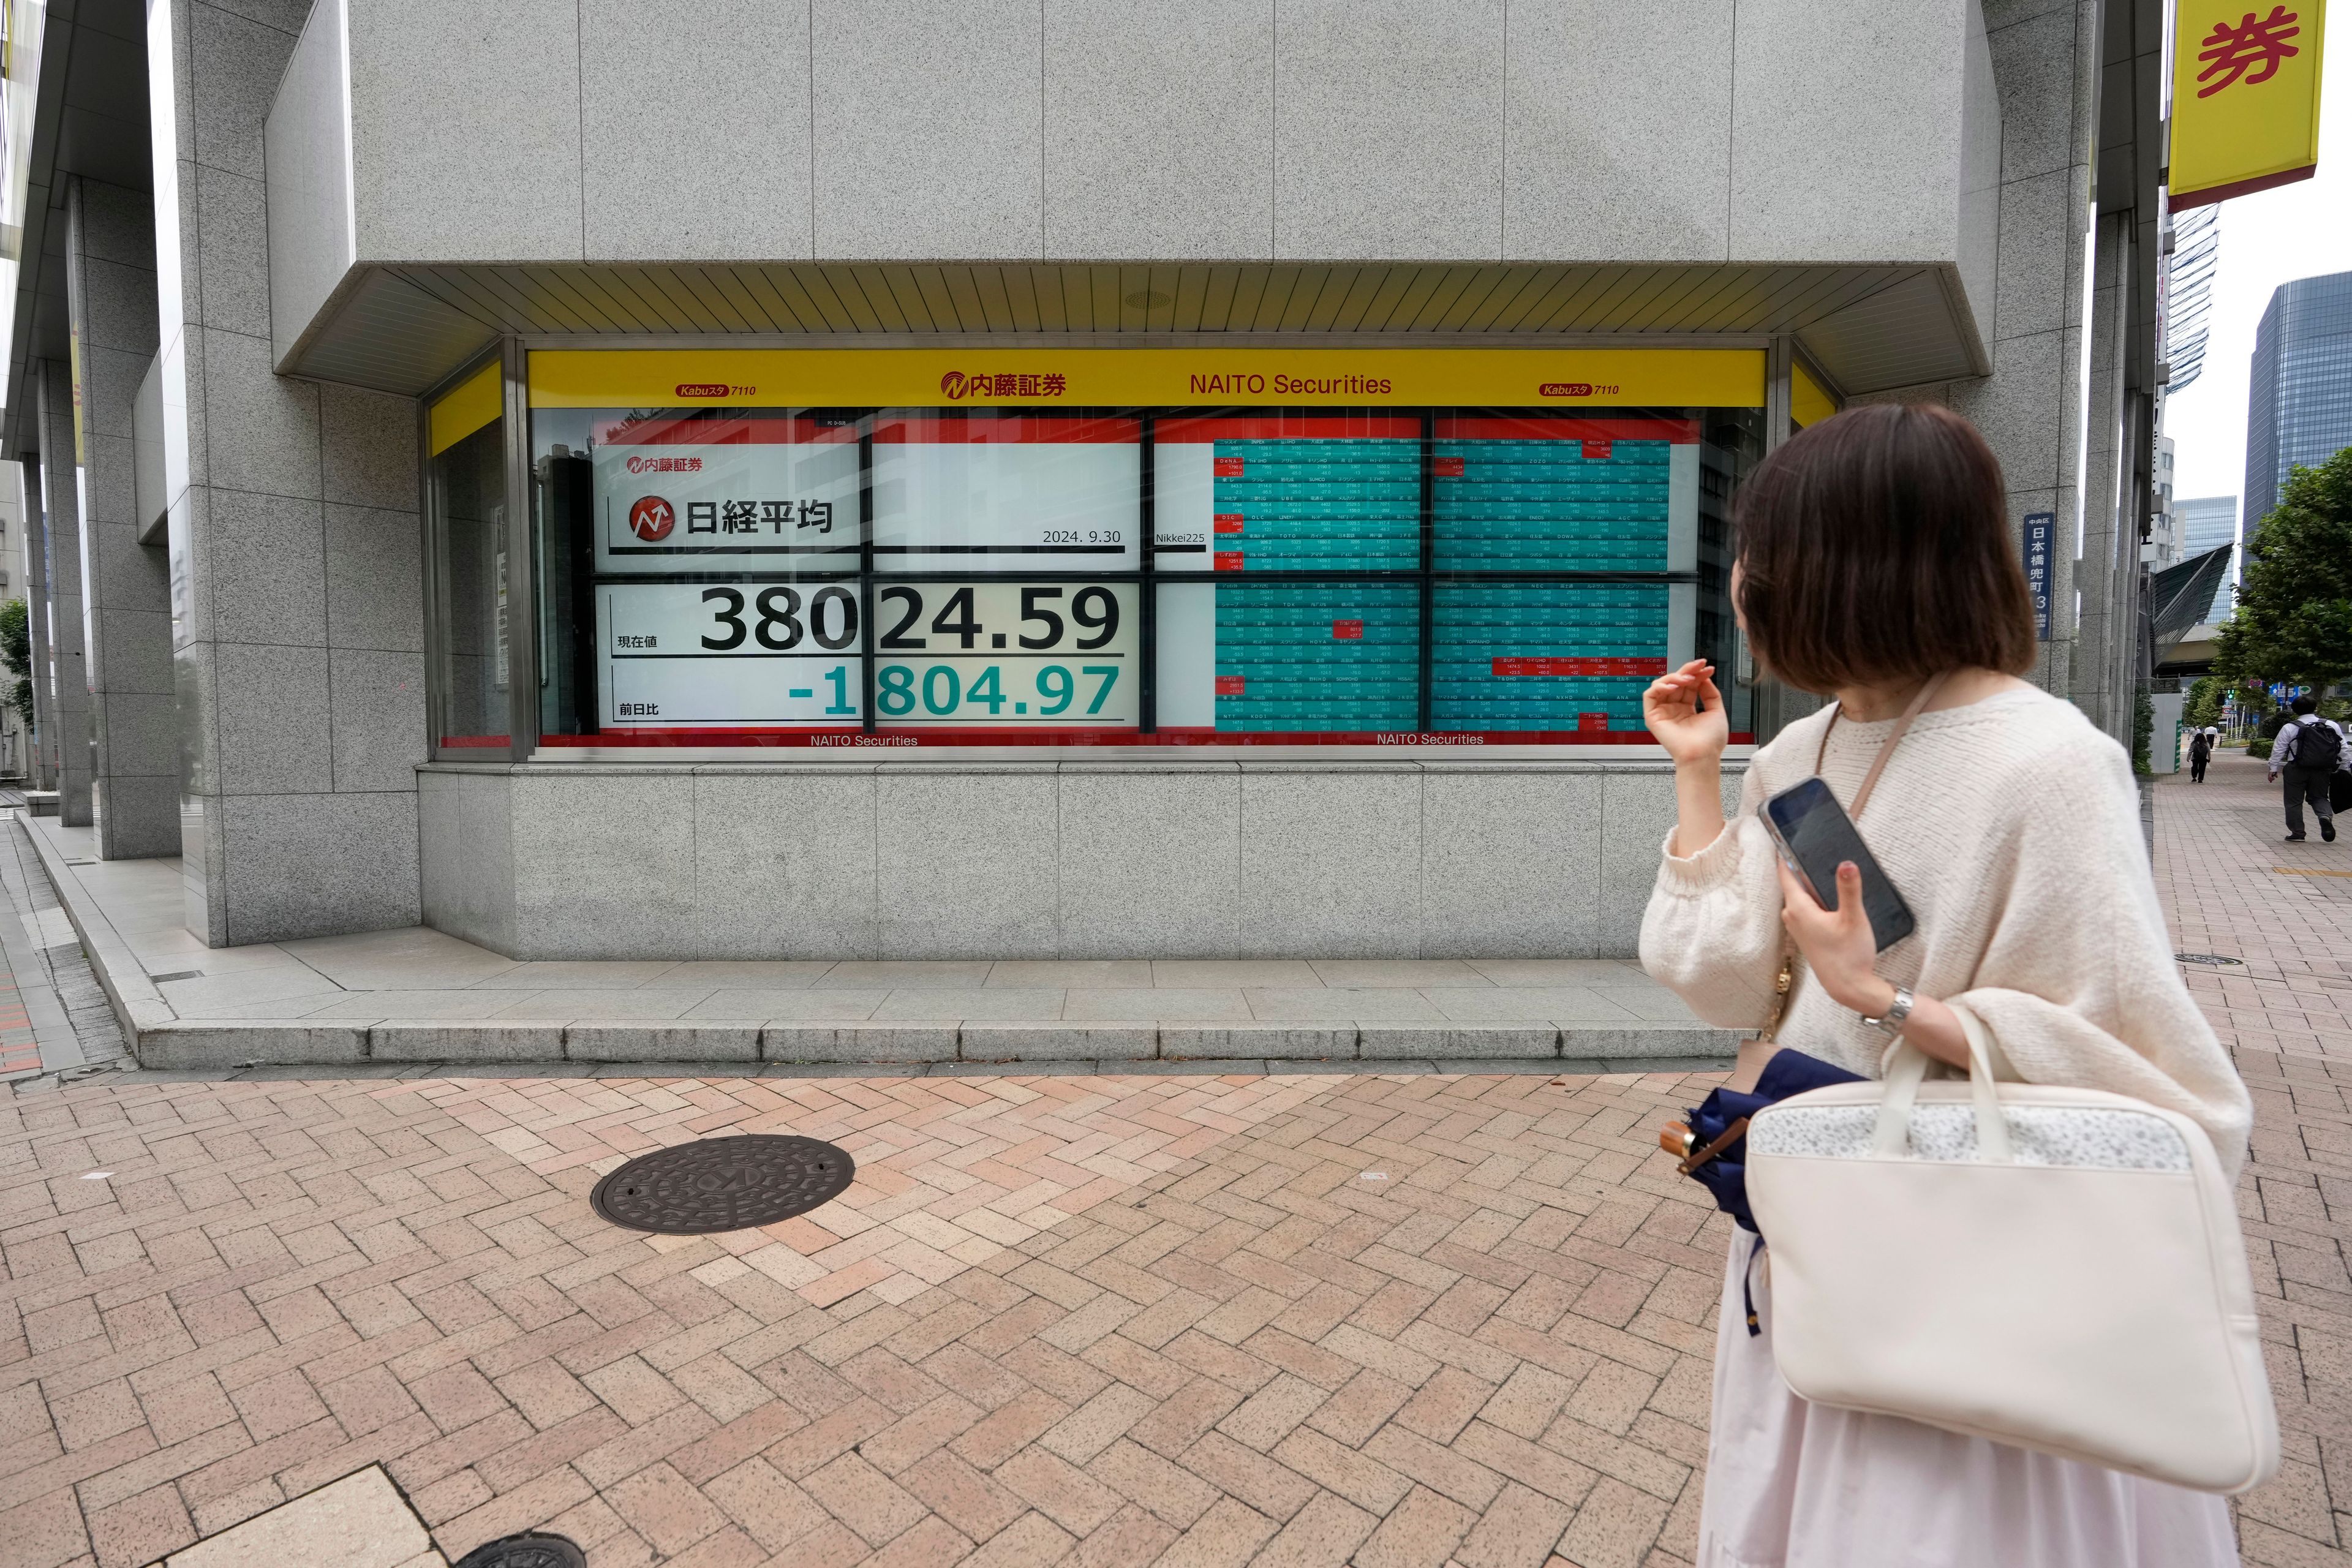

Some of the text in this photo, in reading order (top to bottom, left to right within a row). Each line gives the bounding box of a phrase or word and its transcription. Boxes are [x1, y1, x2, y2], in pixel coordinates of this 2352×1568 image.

[2197, 5, 2300, 99] 券
[680, 385, 756, 396] Kabuスタ 7110
[970, 373, 1066, 396] 内藤証券
[1191, 374, 1392, 394] NAITO Securities
[1544, 385, 1619, 395] Kabuスタ 7110
[644, 458, 703, 472] 内藤証券
[687, 499, 833, 534] 日経平均
[1043, 530, 1121, 542] 2024. 9.30
[1156, 533, 1205, 543] Nikkei225
[2030, 527, 2045, 592] 日本橋兜町
[701, 586, 1120, 650] 38024.59
[617, 635, 657, 648] 現在値
[619, 703, 659, 715] 前日比
[811, 735, 918, 747] NAITO Securities
[1377, 734, 1483, 745] NAITO Securities
